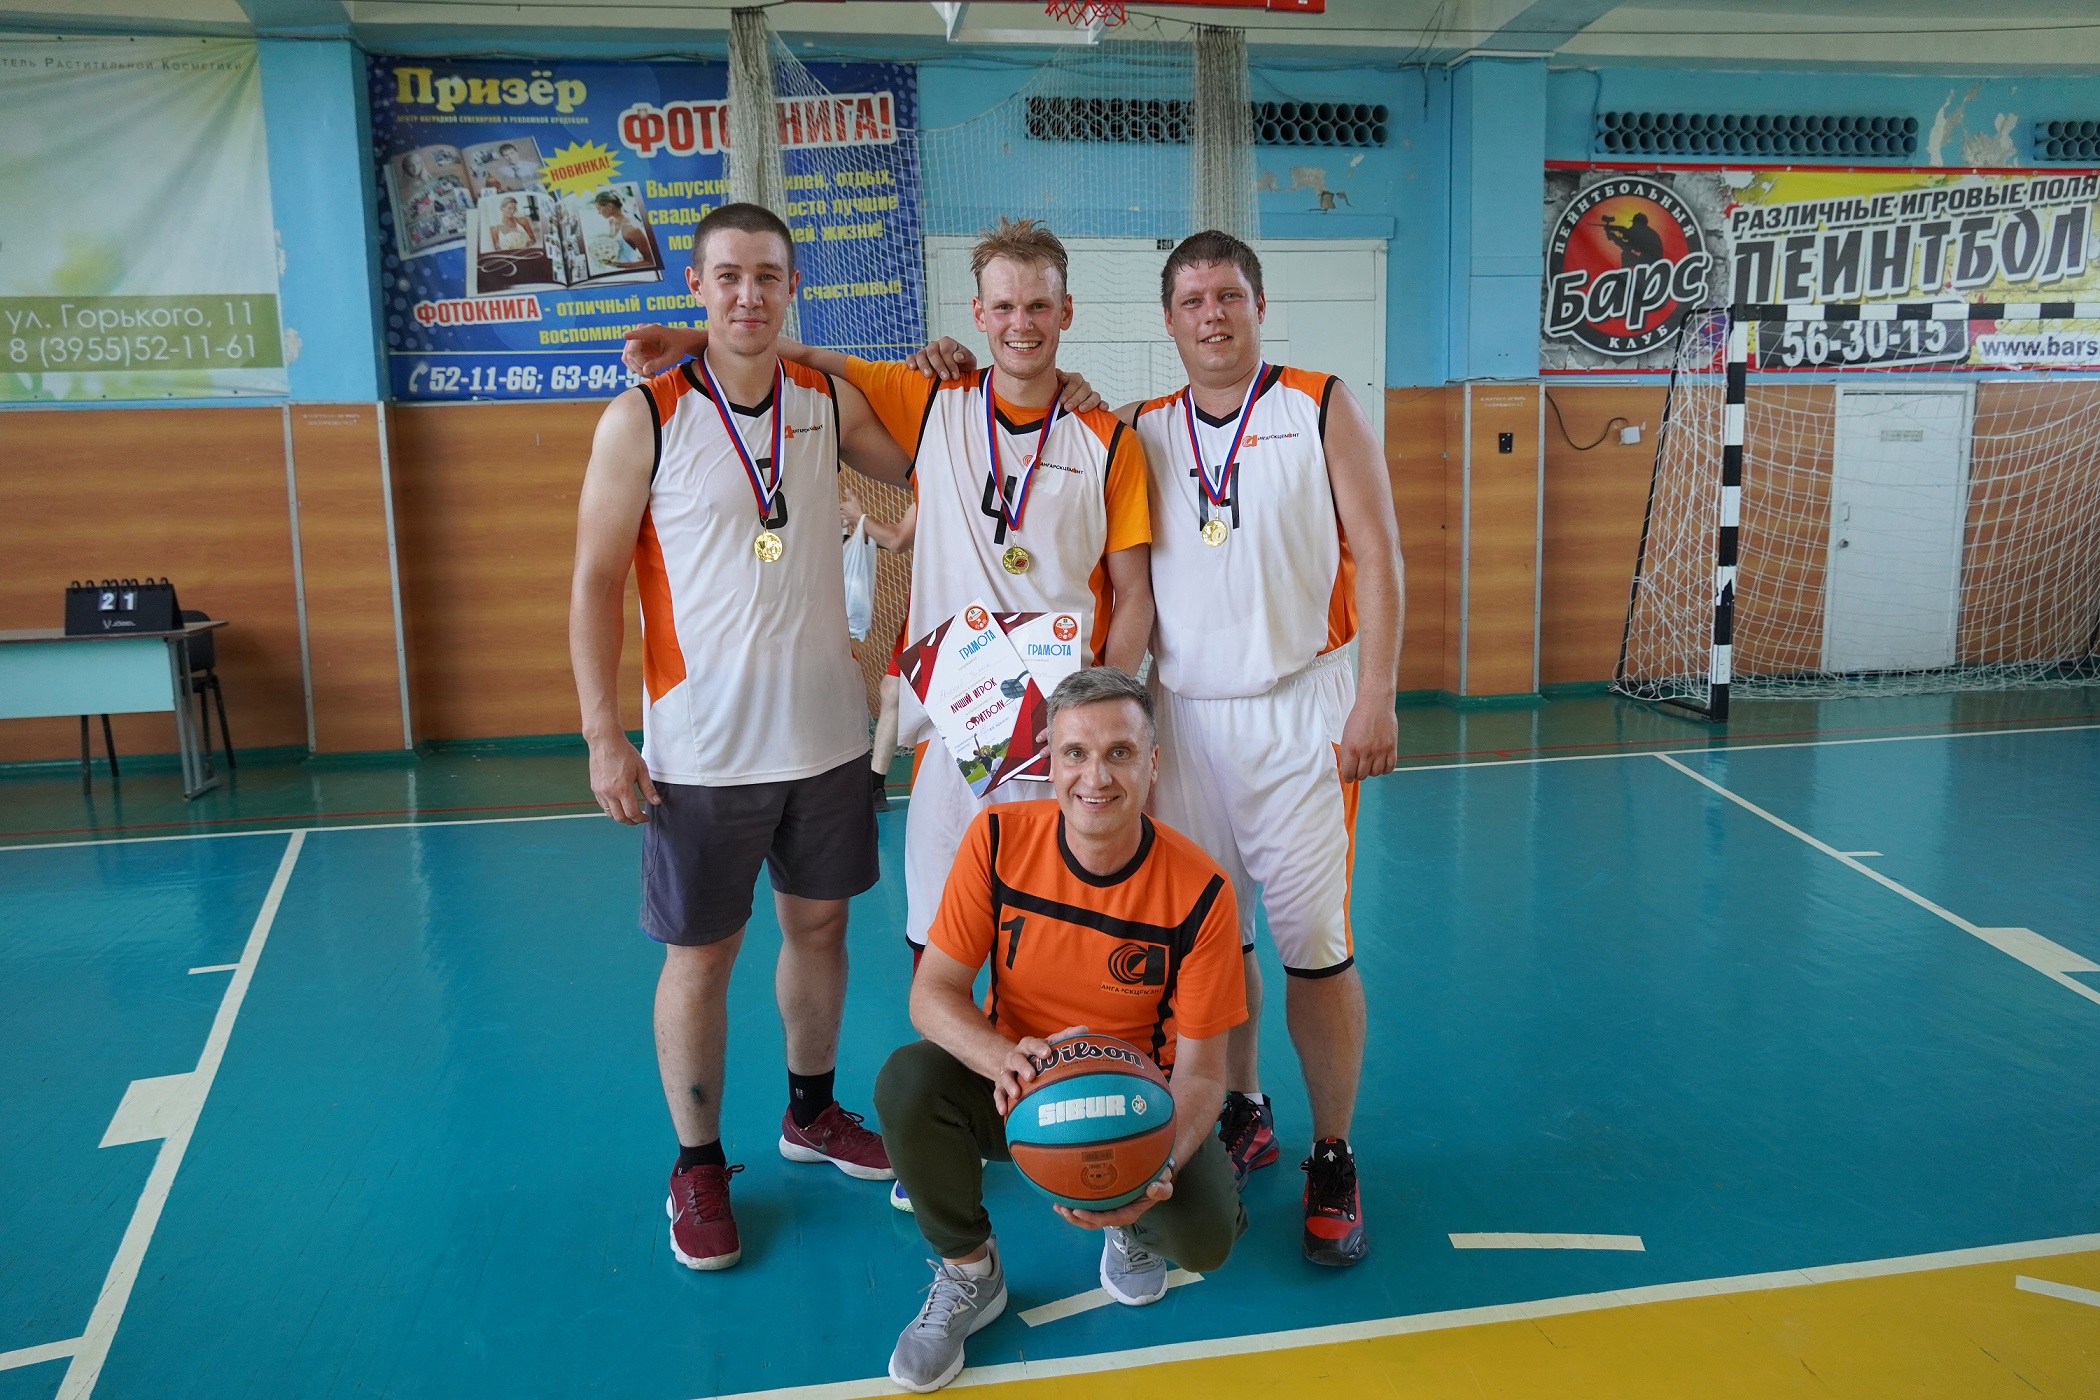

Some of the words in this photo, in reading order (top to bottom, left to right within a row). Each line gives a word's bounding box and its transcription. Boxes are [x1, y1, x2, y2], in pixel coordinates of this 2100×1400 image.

[393, 67, 587, 114] Призёр
[550, 156, 611, 182] НОВИНКА!
[646, 180, 730, 199] Выпускн
[1732, 196, 1895, 232] РАЗЛИЧНЫЕ
[1900, 182, 2025, 216] ИГРОВЫЕ
[2029, 175, 2098, 202] ПОЛЯ
[647, 203, 719, 225] свадьб
[787, 200, 826, 217] осто
[832, 195, 898, 216] лучшие
[1553, 181, 1697, 255] ПЕЙНТБОЛЬНЫЙ
[821, 219, 884, 242] жизни!
[416, 297, 540, 325] ФОТОКНИГА
[802, 279, 904, 301] счастливые
[1545, 252, 1711, 336] Барс
[4, 309, 52, 330] ул.
[61, 303, 213, 333] Горького,
[225, 301, 253, 325] 11
[9, 339, 28, 363] 8
[40, 334, 256, 368] (3955)52-11-61
[1608, 324, 1669, 349] КЛУБ
[1781, 319, 1947, 367] 56-30-15
[1982, 336, 2100, 356] www.bars
[428, 365, 543, 393] 52-11-66;
[981, 470, 1018, 546] 4
[1189, 462, 1240, 532] 14
[958, 628, 997, 660] ГРАМОТА
[1026, 643, 1072, 656] ГРАМОТА
[950, 691, 973, 715] ЛУЧШИЙ
[972, 676, 997, 700] ИГРОК
[1000, 915, 1026, 970] 1
[1028, 1041, 1145, 1078] Wilson
[1038, 1095, 1126, 1127] SIBUR
